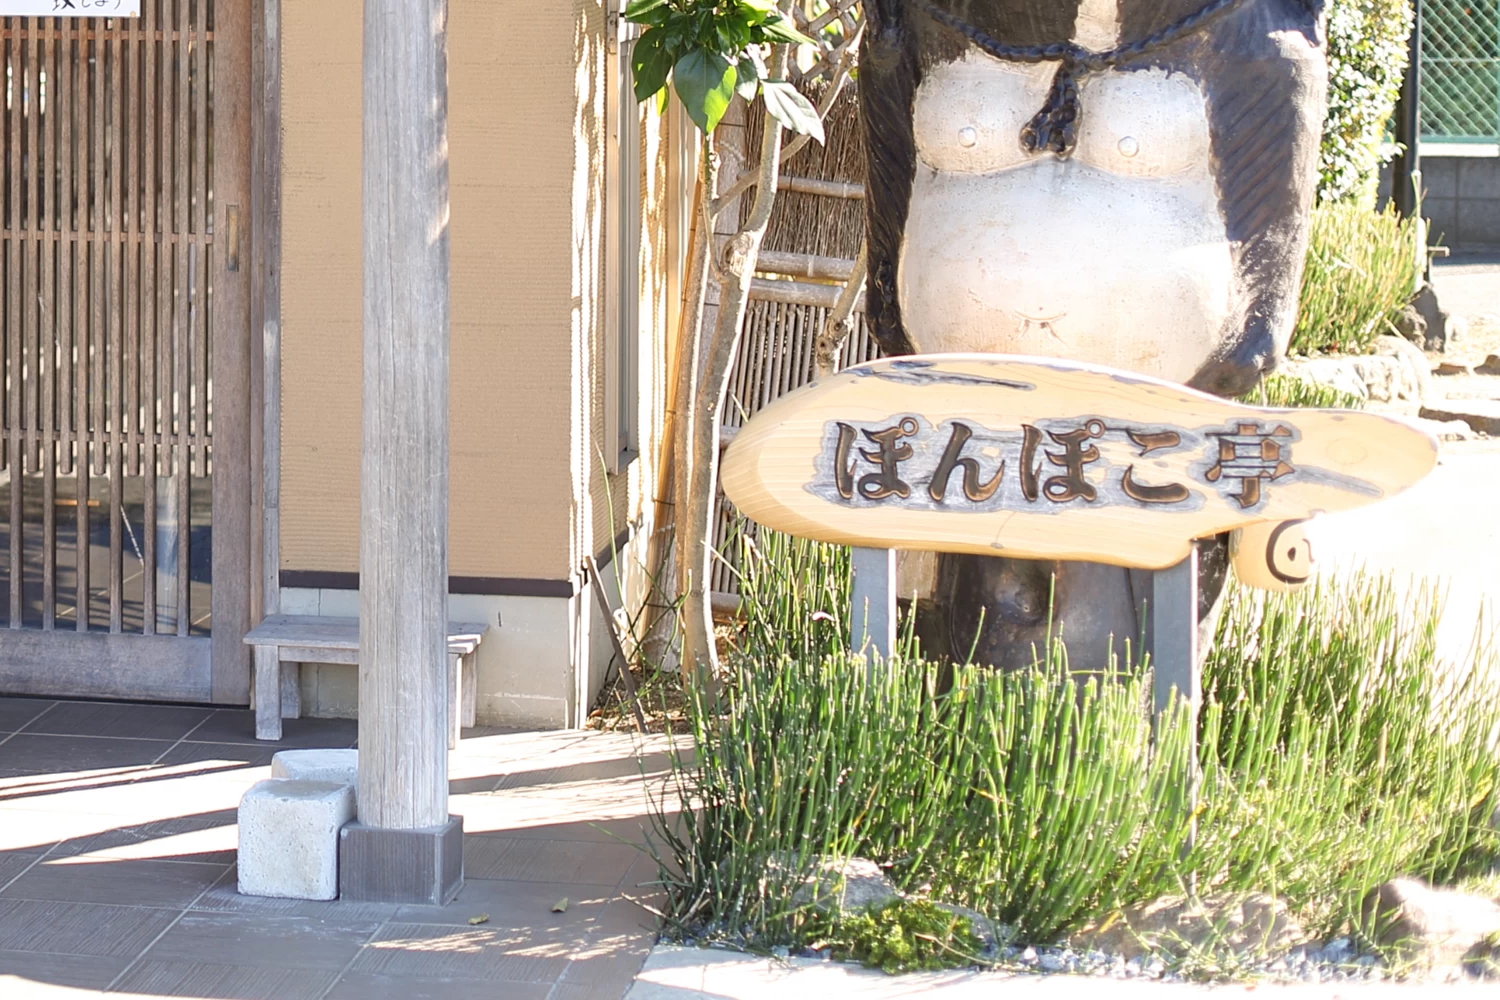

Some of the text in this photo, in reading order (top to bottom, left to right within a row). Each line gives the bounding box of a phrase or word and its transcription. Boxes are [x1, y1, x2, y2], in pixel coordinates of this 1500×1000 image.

[834, 416, 1295, 509] ぽんぽこ亭
